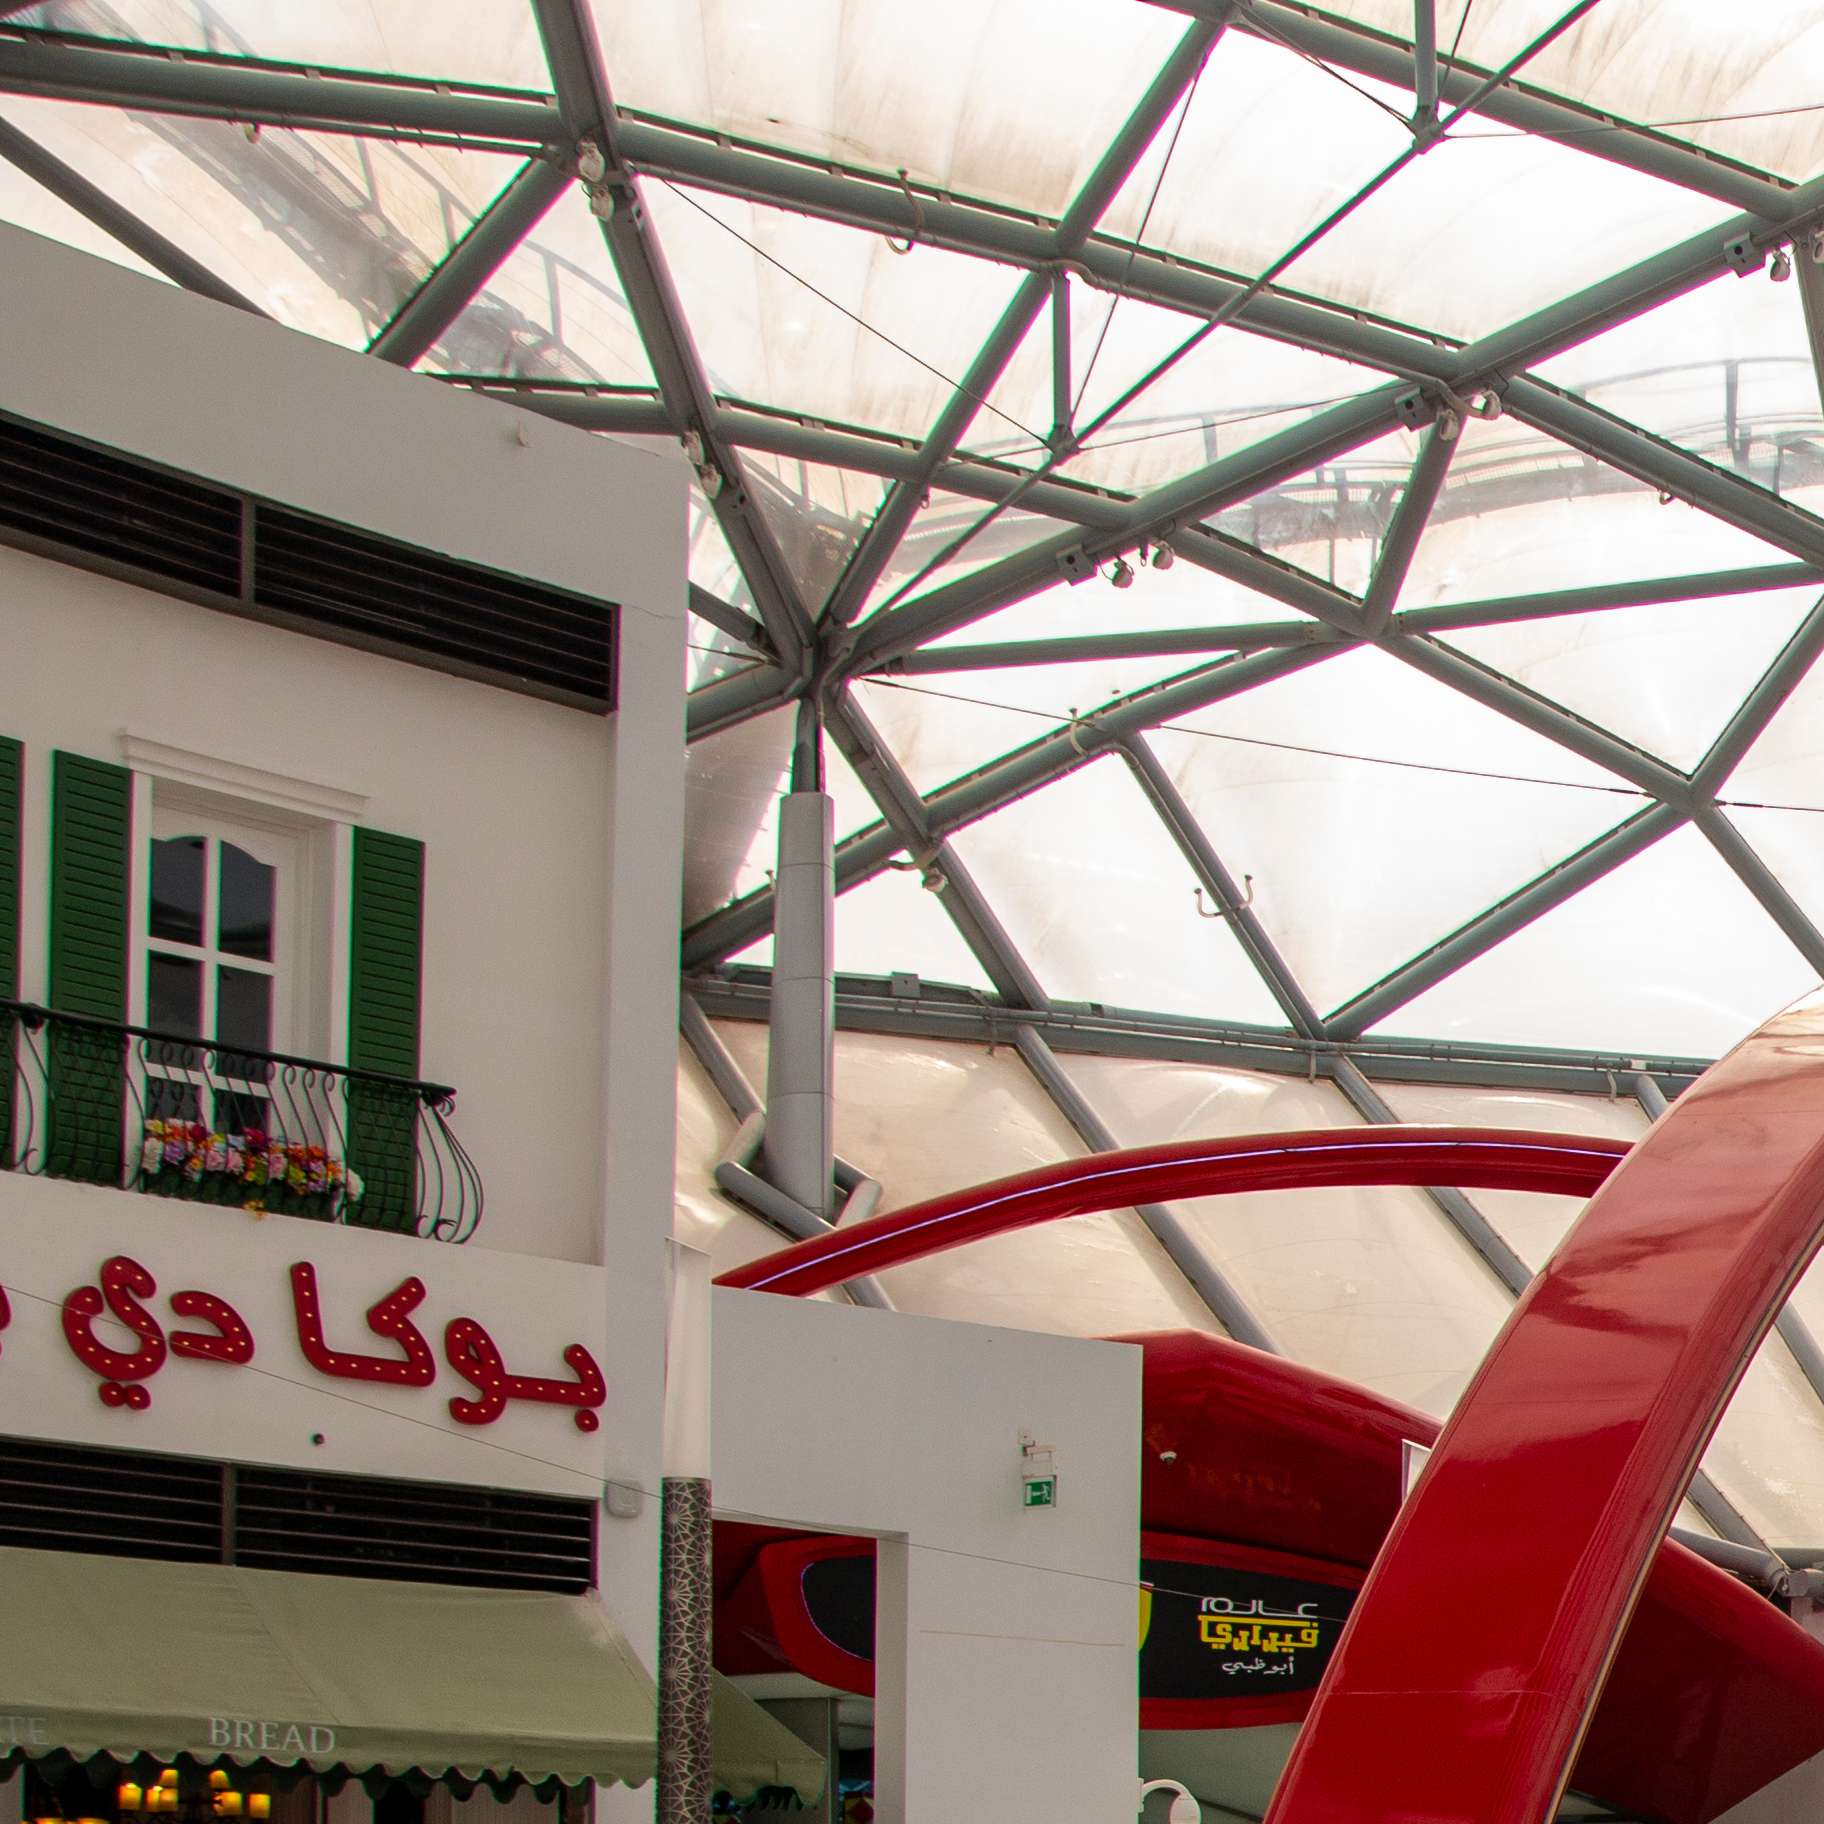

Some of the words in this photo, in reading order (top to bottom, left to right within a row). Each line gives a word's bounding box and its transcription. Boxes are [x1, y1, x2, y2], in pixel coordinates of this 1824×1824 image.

[62, 1255, 255, 1411] دي
[290, 1259, 607, 1433] بوكا
[1201, 1597, 1318, 1619] عالم
[1198, 1615, 1320, 1653] فيراري
[208, 1716, 337, 1754] BREAD
